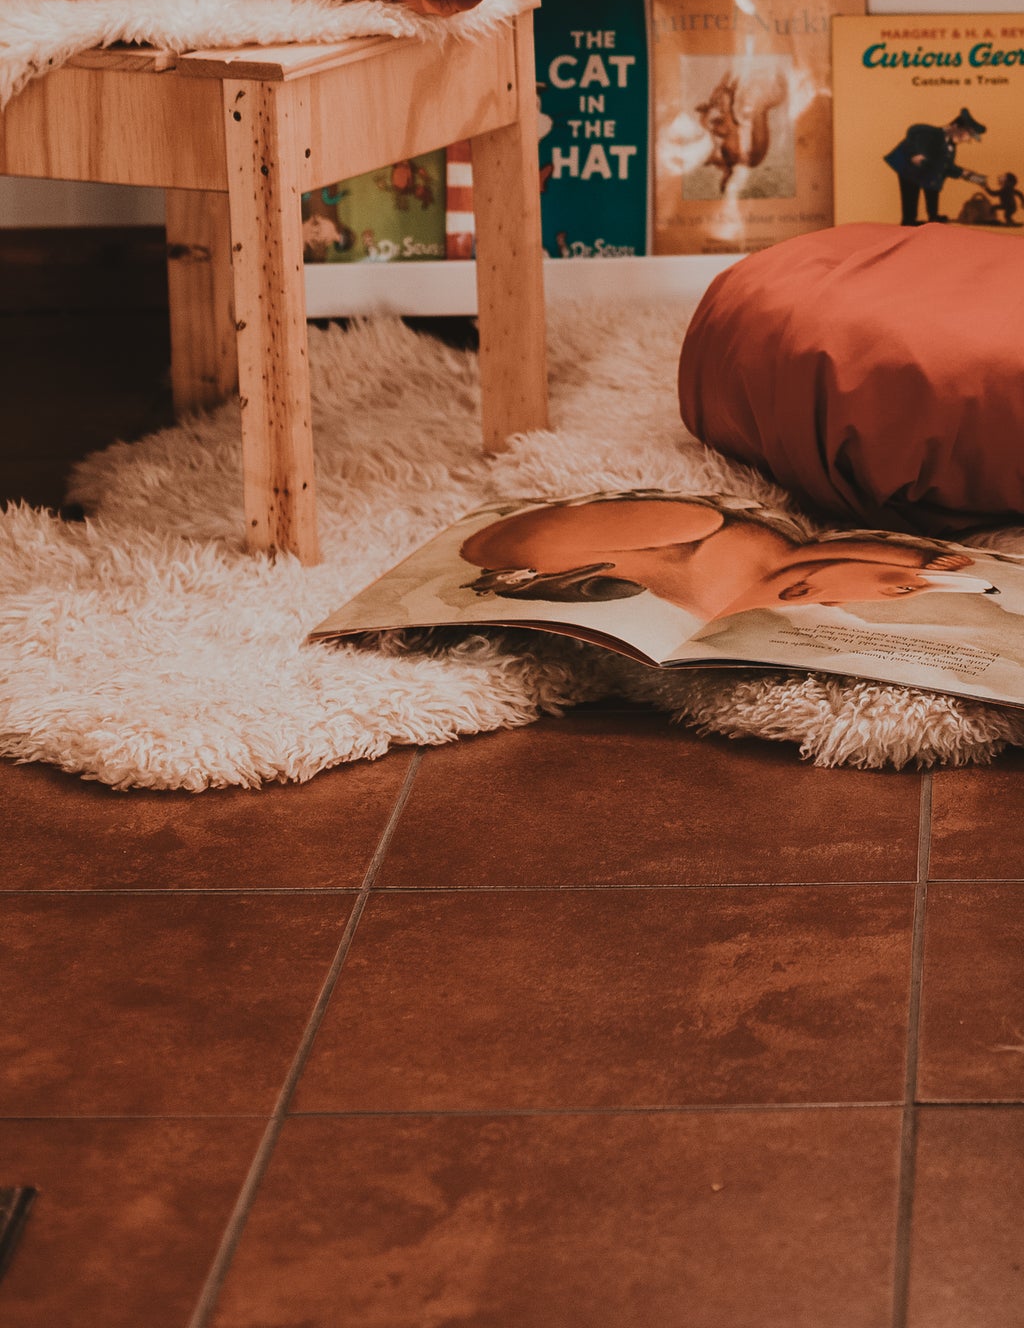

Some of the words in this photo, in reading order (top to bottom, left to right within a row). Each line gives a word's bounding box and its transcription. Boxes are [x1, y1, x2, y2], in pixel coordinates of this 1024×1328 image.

[570, 30, 616, 49] THE
[880, 28, 947, 40] MARGRET
[862, 42, 963, 68] Curious
[548, 54, 636, 89] CAT
[912, 76, 960, 86] Catches
[977, 75, 1009, 86] Train
[579, 94, 605, 113] IN
[567, 120, 616, 138] THE
[551, 143, 637, 180] HAT
